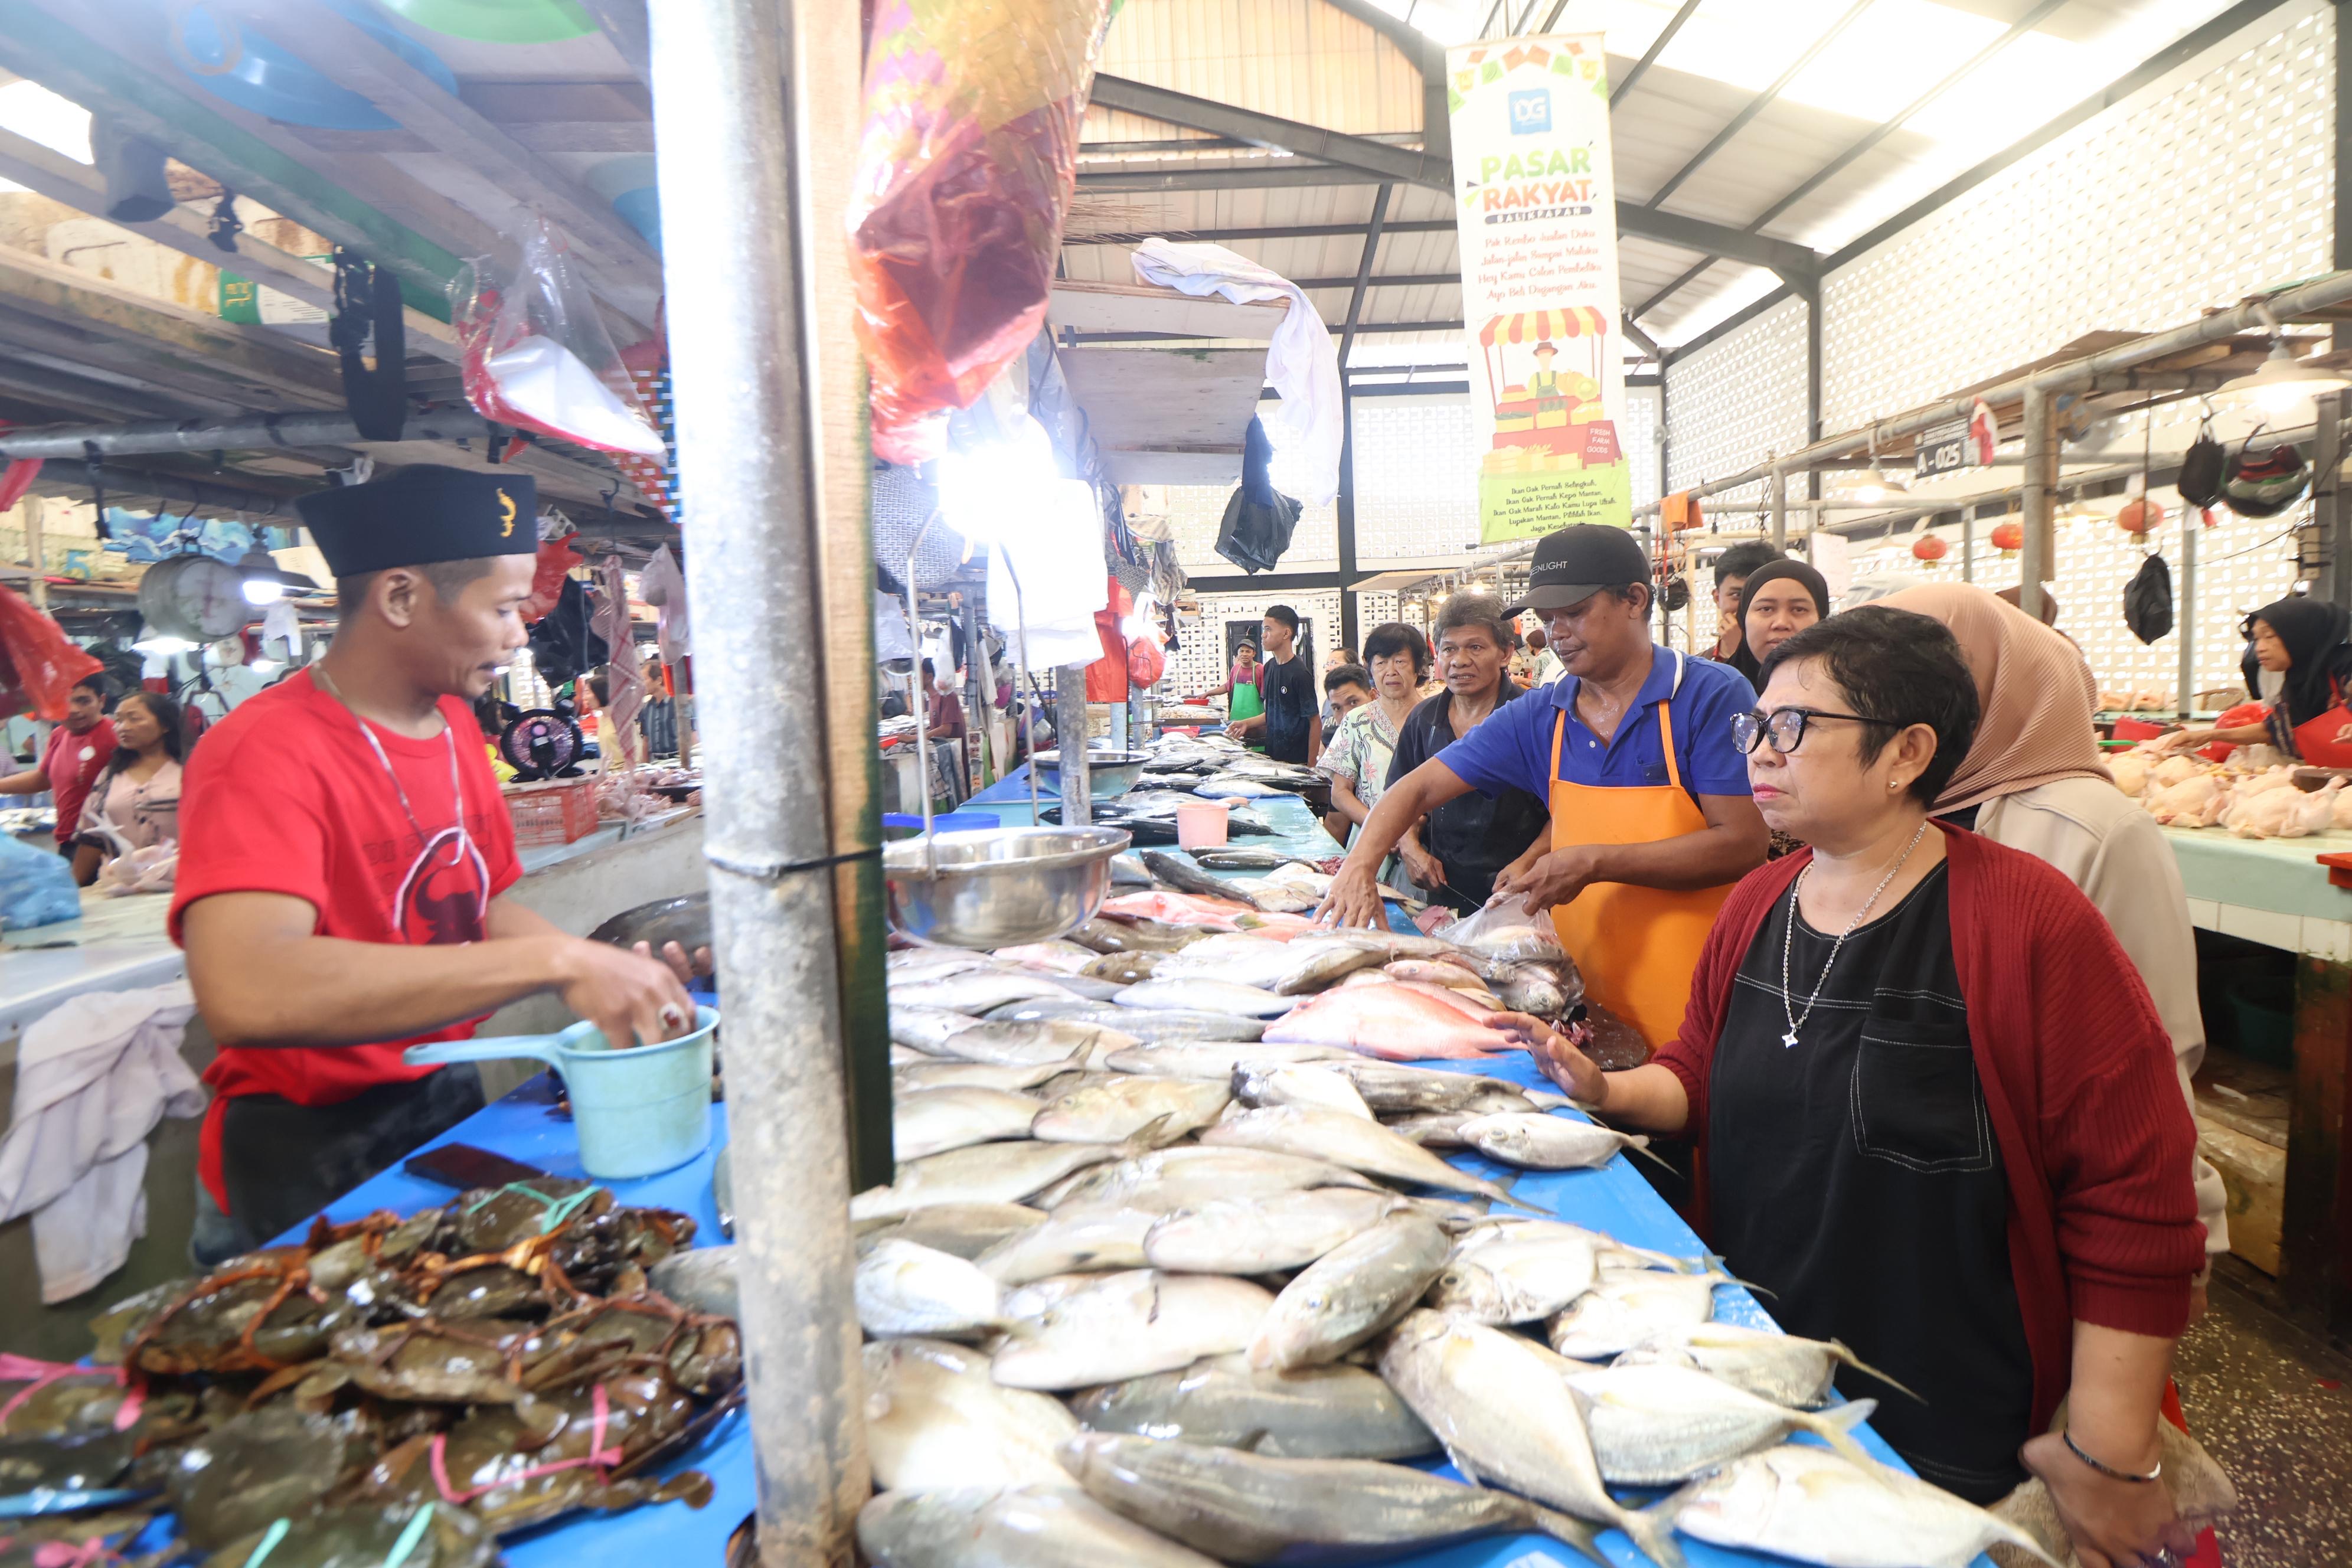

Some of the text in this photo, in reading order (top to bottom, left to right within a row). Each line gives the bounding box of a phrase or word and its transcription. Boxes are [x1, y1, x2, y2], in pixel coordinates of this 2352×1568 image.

[1515, 97, 1546, 121] DG
[1481, 146, 1592, 184] PASAR
[1483, 179, 1593, 213] RAKYAT
[1497, 207, 1582, 223] BALIKPAPAN
[1478, 273, 1498, 286] Hey
[1500, 270, 1525, 281] Kamu
[1486, 289, 1505, 302] Ayo
[1509, 285, 1525, 297] Beli
[1590, 427, 1611, 436] FRESH
[1592, 436, 1611, 445] FARM
[1586, 445, 1609, 454] GOODS
[1541, 482, 1562, 491] Pernah
[1536, 493, 1557, 502] Pernah
[1559, 492, 1576, 501] Kepo
[1523, 504, 1543, 513] Marah
[1545, 502, 1560, 511] Kalo
[1582, 500, 1597, 509] Lupa
[1509, 517, 1534, 527] Lupakan
